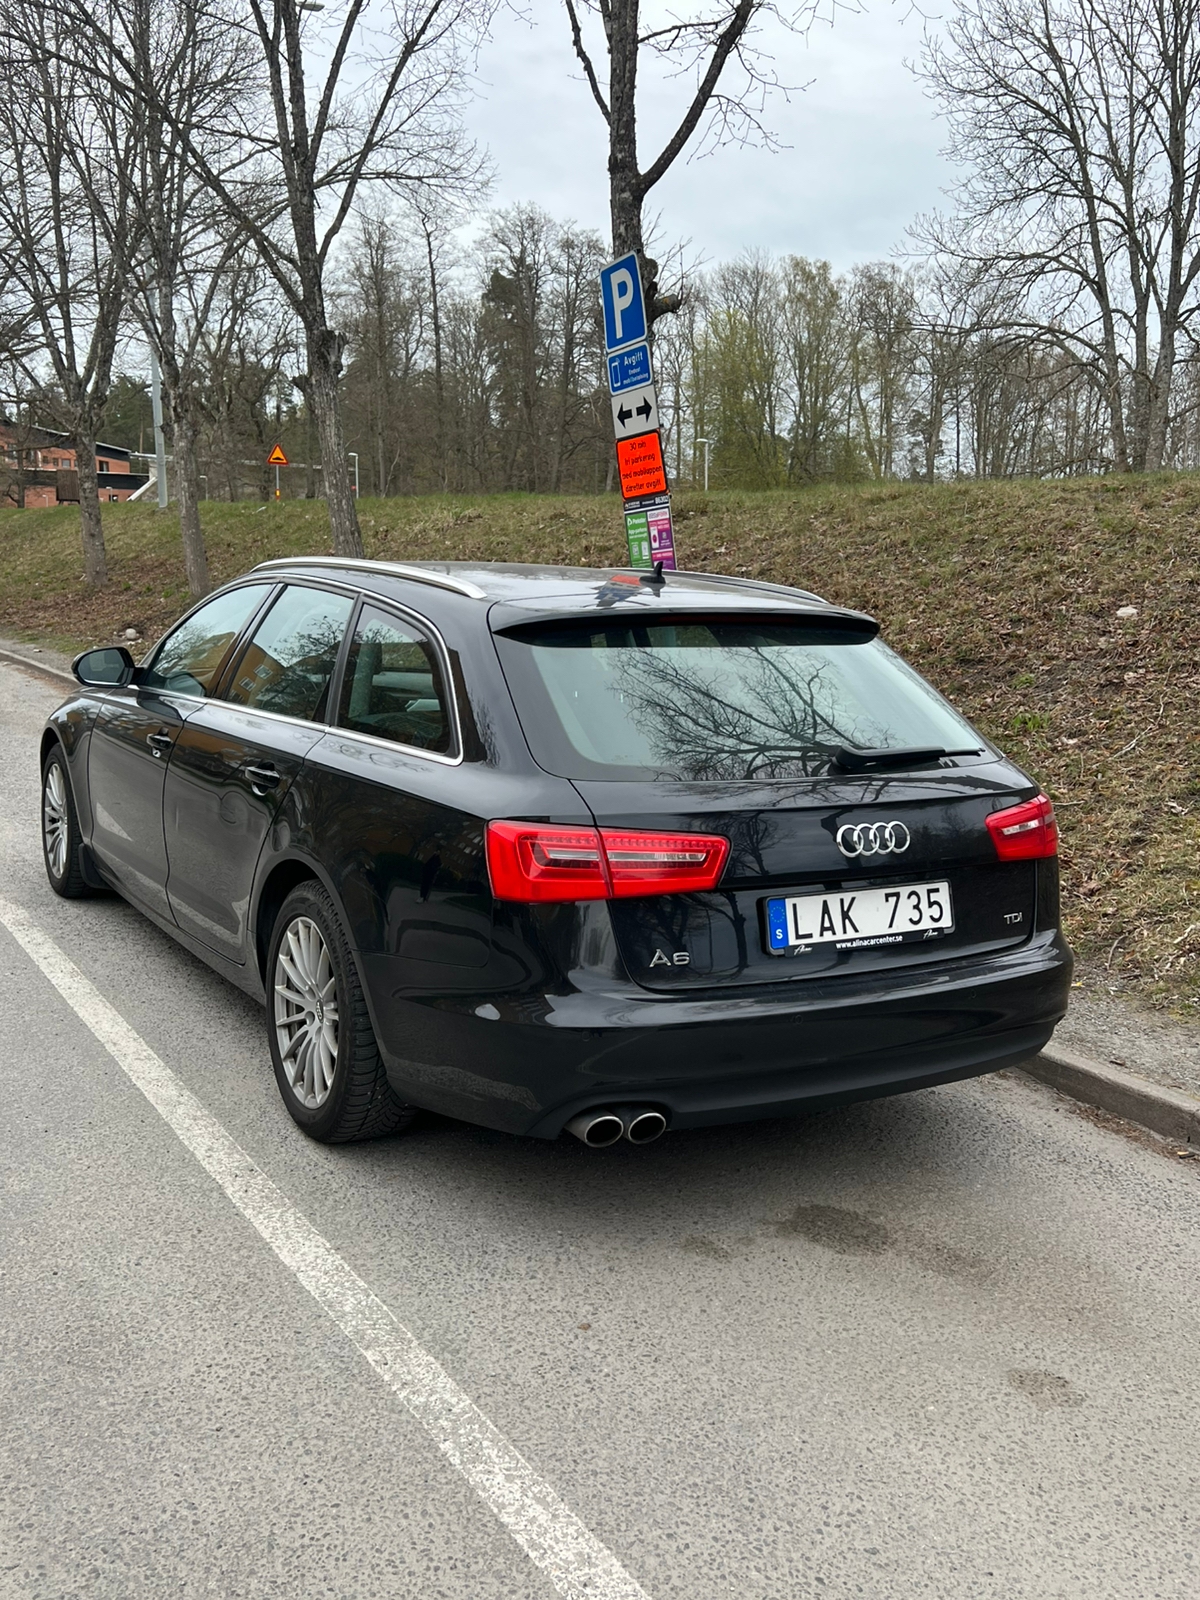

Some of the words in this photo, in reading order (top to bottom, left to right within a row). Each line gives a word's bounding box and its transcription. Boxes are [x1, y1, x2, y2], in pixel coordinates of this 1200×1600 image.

[610, 267, 634, 340] P
[624, 351, 644, 366] Avgift
[629, 442, 637, 451] 30
[631, 453, 656, 465] parkering
[645, 478, 662, 490] avgift
[792, 896, 860, 940] LAK
[884, 887, 944, 929] 735
[1003, 911, 1023, 925] TDI
[775, 928, 783, 940] S
[836, 934, 903, 949] www.alinacarcenter.se
[649, 948, 690, 968] A6
